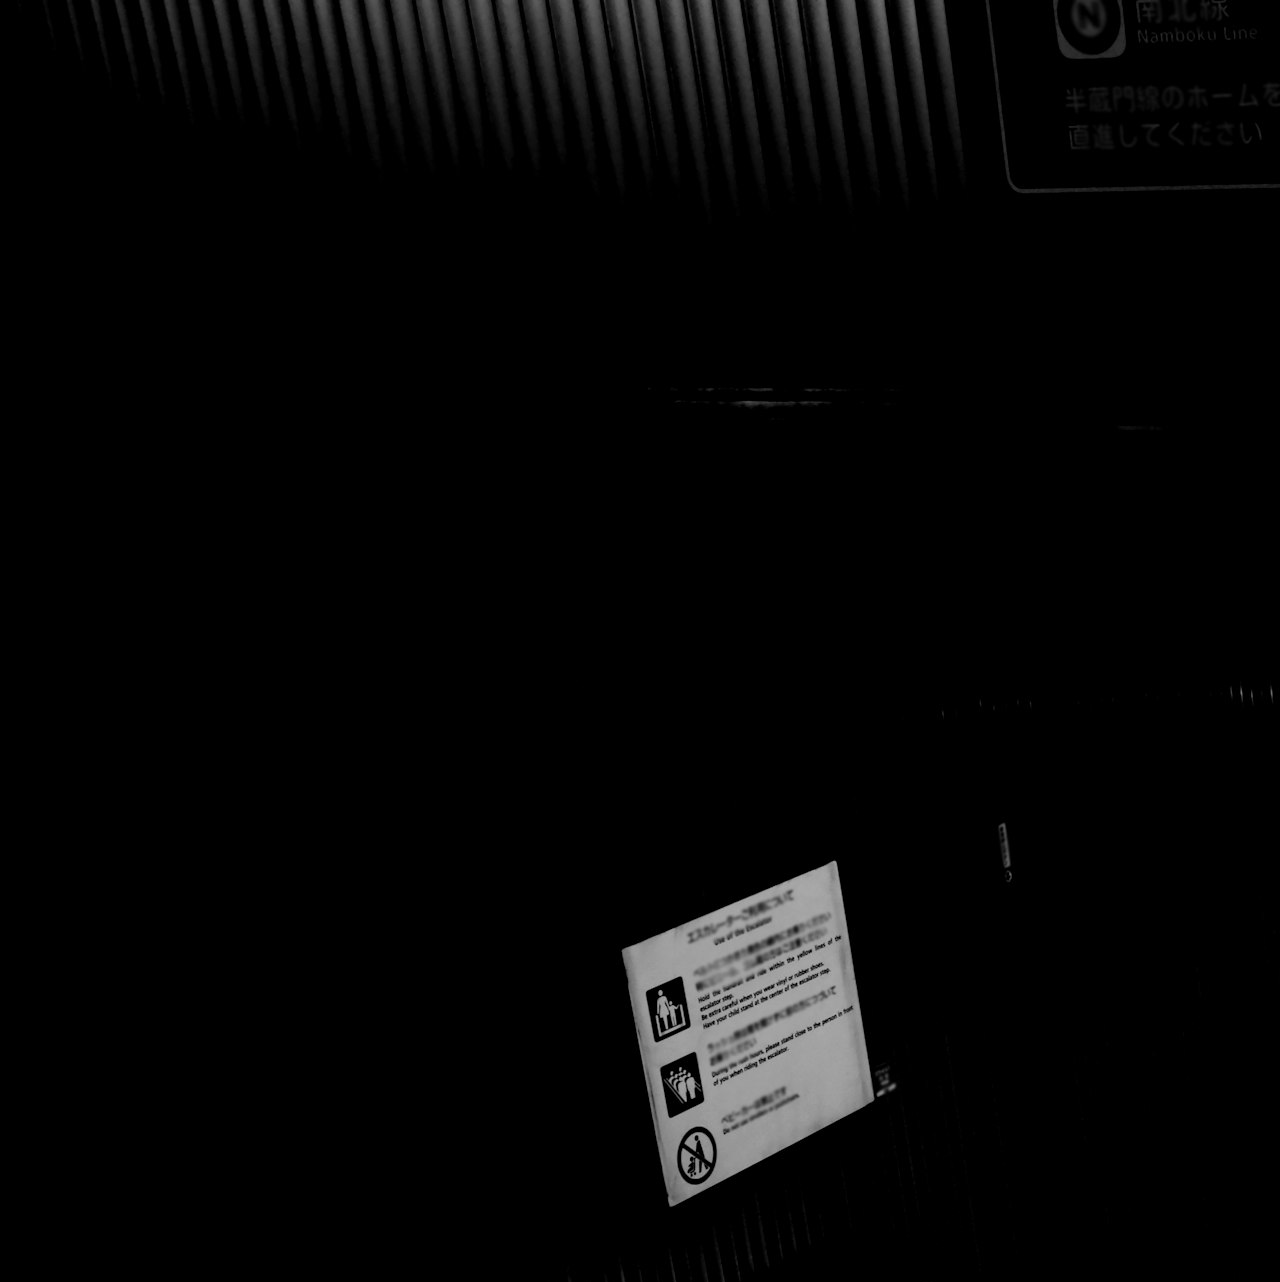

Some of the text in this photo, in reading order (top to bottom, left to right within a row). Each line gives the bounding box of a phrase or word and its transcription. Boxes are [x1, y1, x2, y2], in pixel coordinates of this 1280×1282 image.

[1136, 25, 1259, 45] Namboku Line
[1067, 121, 1264, 152] 直進してください
[698, 994, 710, 1003] Hold
[769, 961, 784, 971] within
[797, 949, 812, 960] yellow
[709, 1009, 721, 1017] extra
[722, 999, 738, 1011] careful
[739, 994, 753, 1003] when
[763, 984, 775, 992] wear
[776, 977, 787, 986] vinyl
[794, 969, 809, 978] rubber
[700, 999, 721, 1012] escalator
[703, 1021, 715, 1029] Have
[716, 1015, 727, 1024] your
[728, 1008, 739, 1017] child
[740, 1002, 753, 1012] stand
[769, 989, 783, 999] center
[799, 973, 819, 985] escalator
[766, 1042, 780, 1053] please
[781, 1034, 794, 1044] stand
[795, 1029, 806, 1037] close
[822, 1015, 837, 1026] person
[843, 1006, 853, 1014] front
[730, 1069, 743, 1078] when
[744, 1062, 758, 1071] riding
